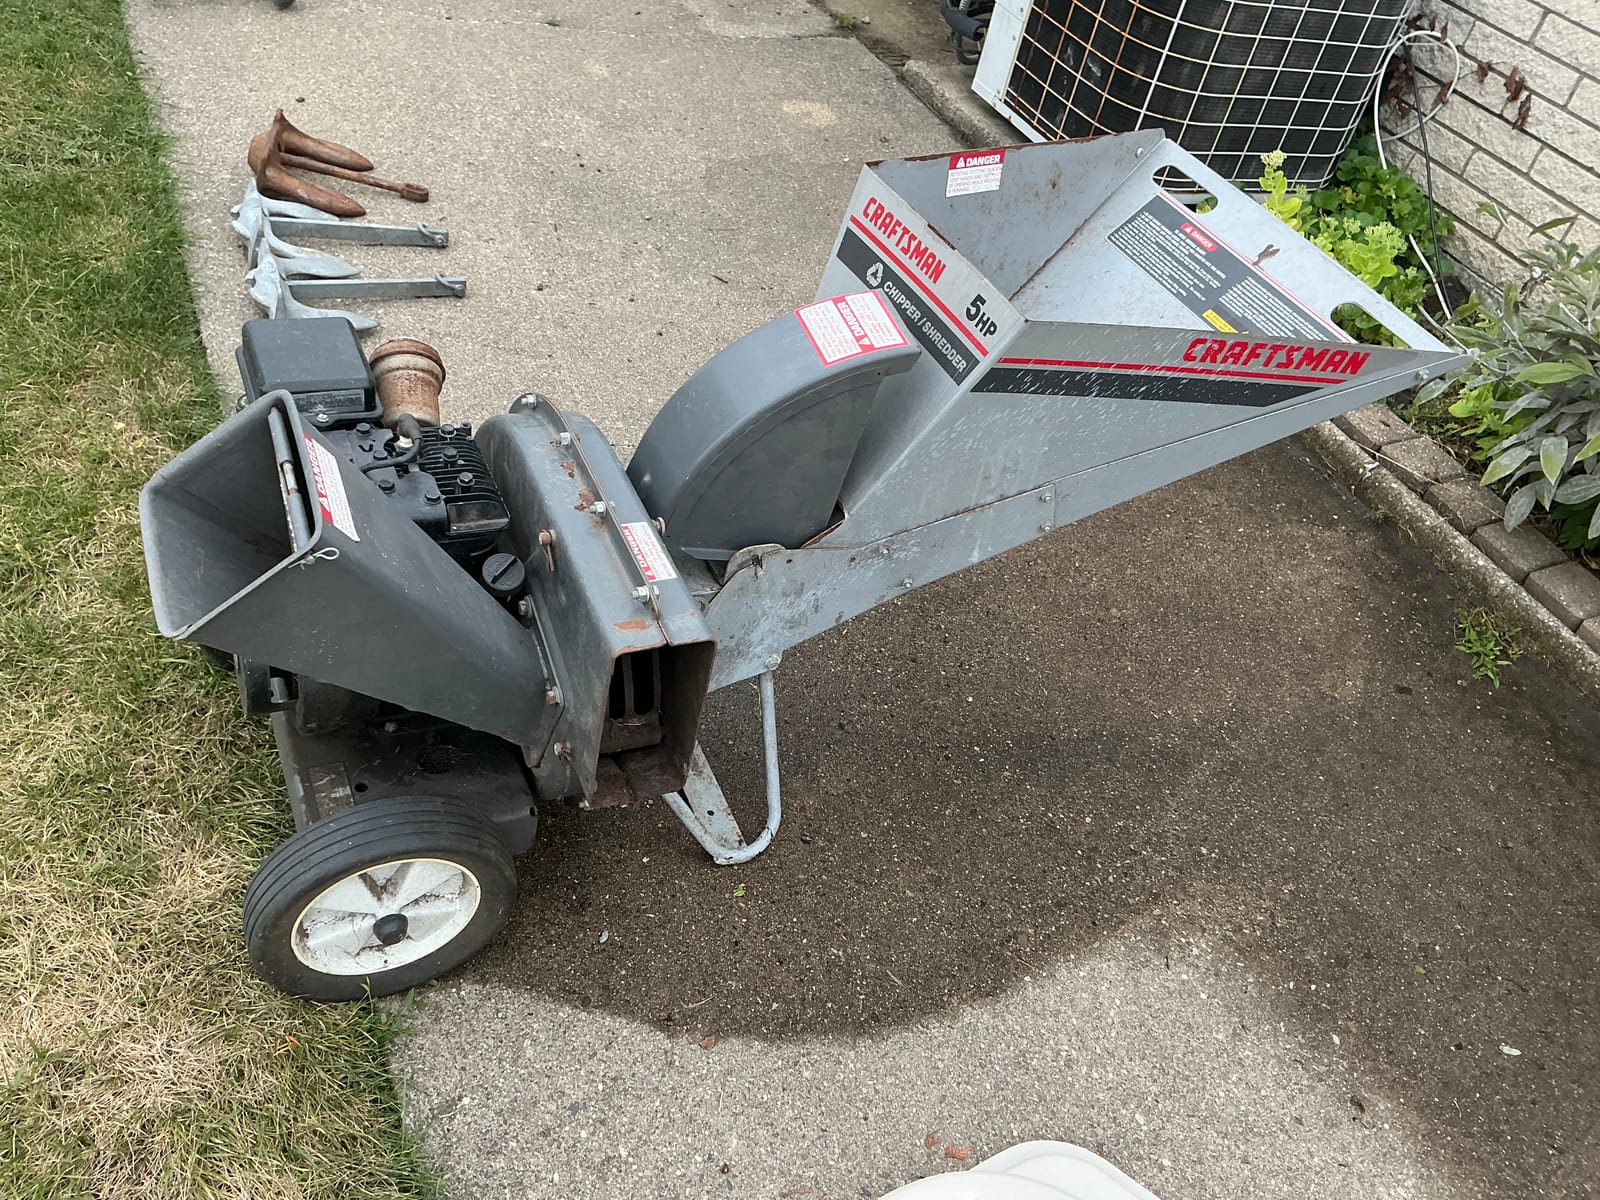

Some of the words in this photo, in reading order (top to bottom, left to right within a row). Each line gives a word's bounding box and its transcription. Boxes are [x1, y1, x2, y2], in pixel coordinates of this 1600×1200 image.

[966, 154, 1001, 167] DANGER
[862, 197, 947, 284] CRAFTSMAN
[1191, 230, 1214, 249] DANGER
[837, 301, 866, 337] DANGER
[1183, 338, 1370, 375] CRAFTSMAN
[305, 439, 327, 494] DANGER
[622, 528, 650, 568] DANGER
